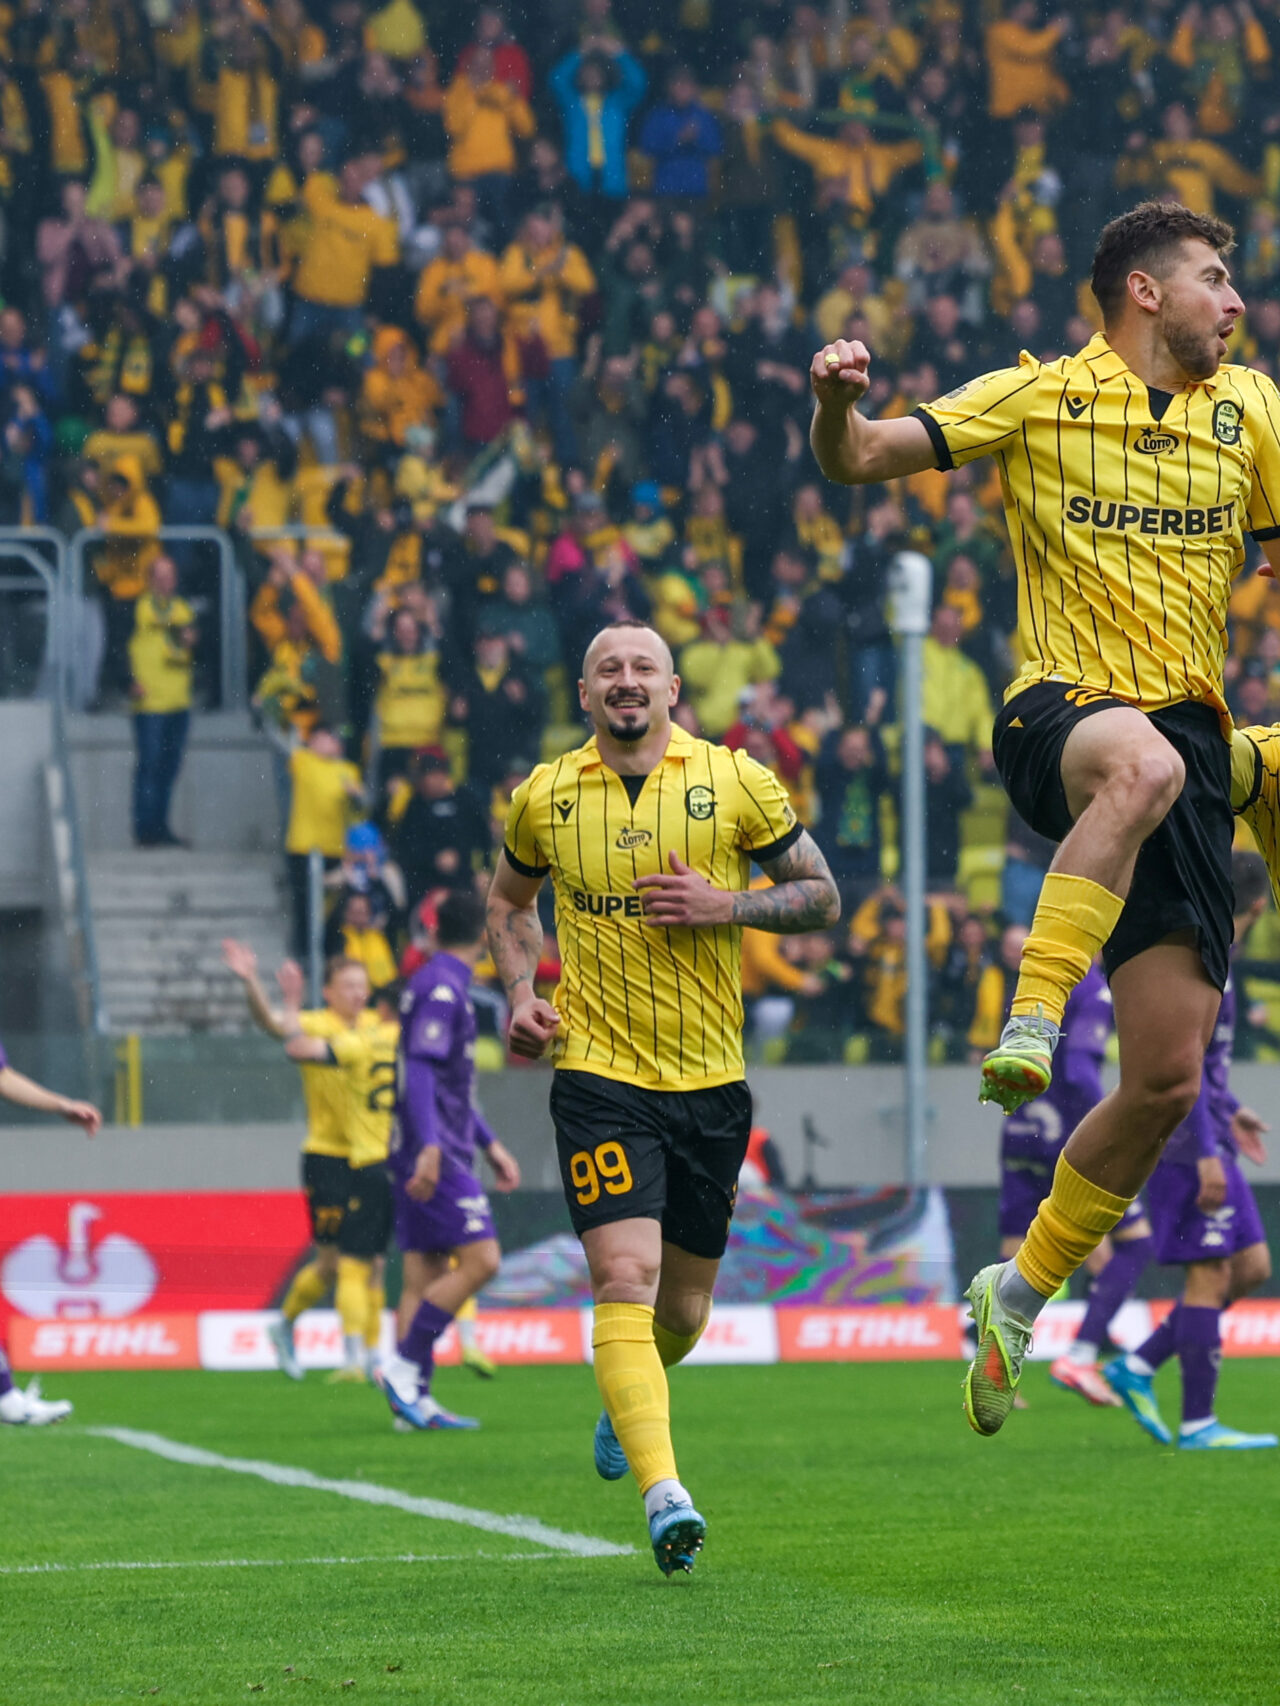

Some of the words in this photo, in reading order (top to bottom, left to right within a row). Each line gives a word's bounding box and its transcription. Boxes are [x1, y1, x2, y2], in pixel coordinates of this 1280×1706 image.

[1143, 438, 1171, 450] LOTTO
[1066, 496, 1234, 536] SUPERBET
[623, 834, 645, 846] LOTTO
[573, 891, 647, 917] SUPE
[570, 1141, 633, 1205] 99
[32, 1322, 179, 1357] STIHL
[797, 1314, 943, 1348] STIHL
